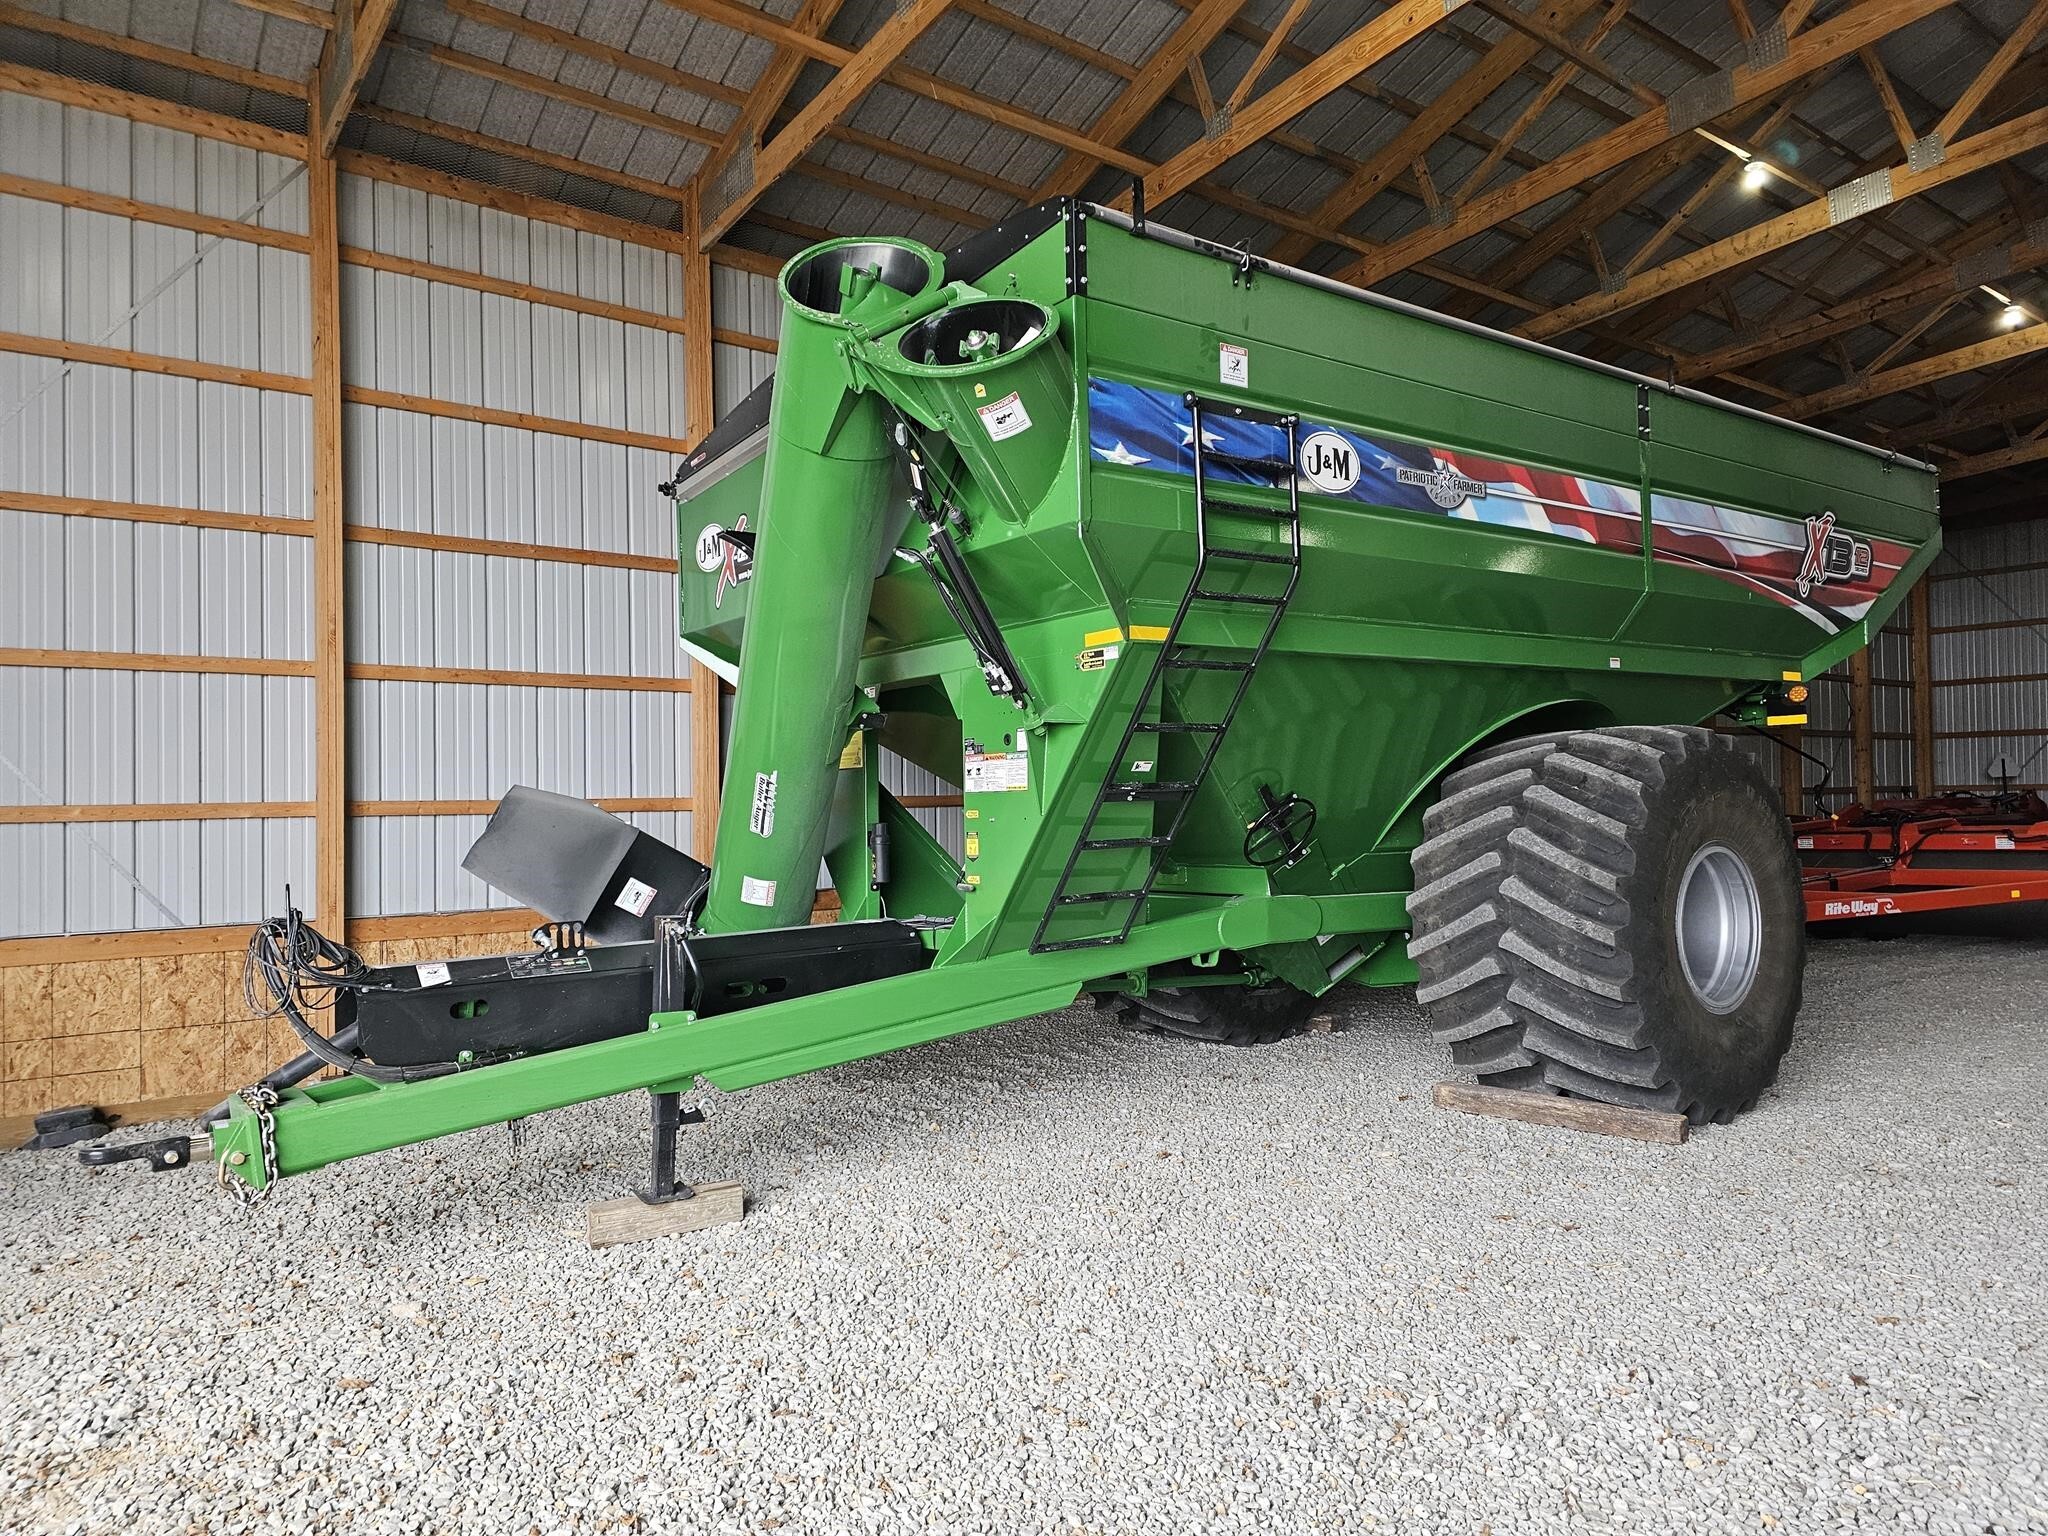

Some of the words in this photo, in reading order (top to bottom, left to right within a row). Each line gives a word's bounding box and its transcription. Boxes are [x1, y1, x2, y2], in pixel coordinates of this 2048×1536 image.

[989, 395, 1014, 412] DANGER
[1307, 443, 1351, 481] J&M
[1399, 468, 1438, 487] PATRIOTIC
[1453, 479, 1484, 495] FARMER
[699, 534, 721, 563] J&M
[757, 776, 766, 803] Bullet
[753, 804, 762, 830] Auger
[1825, 902, 1851, 916] Rite
[1851, 900, 1879, 915] Way
